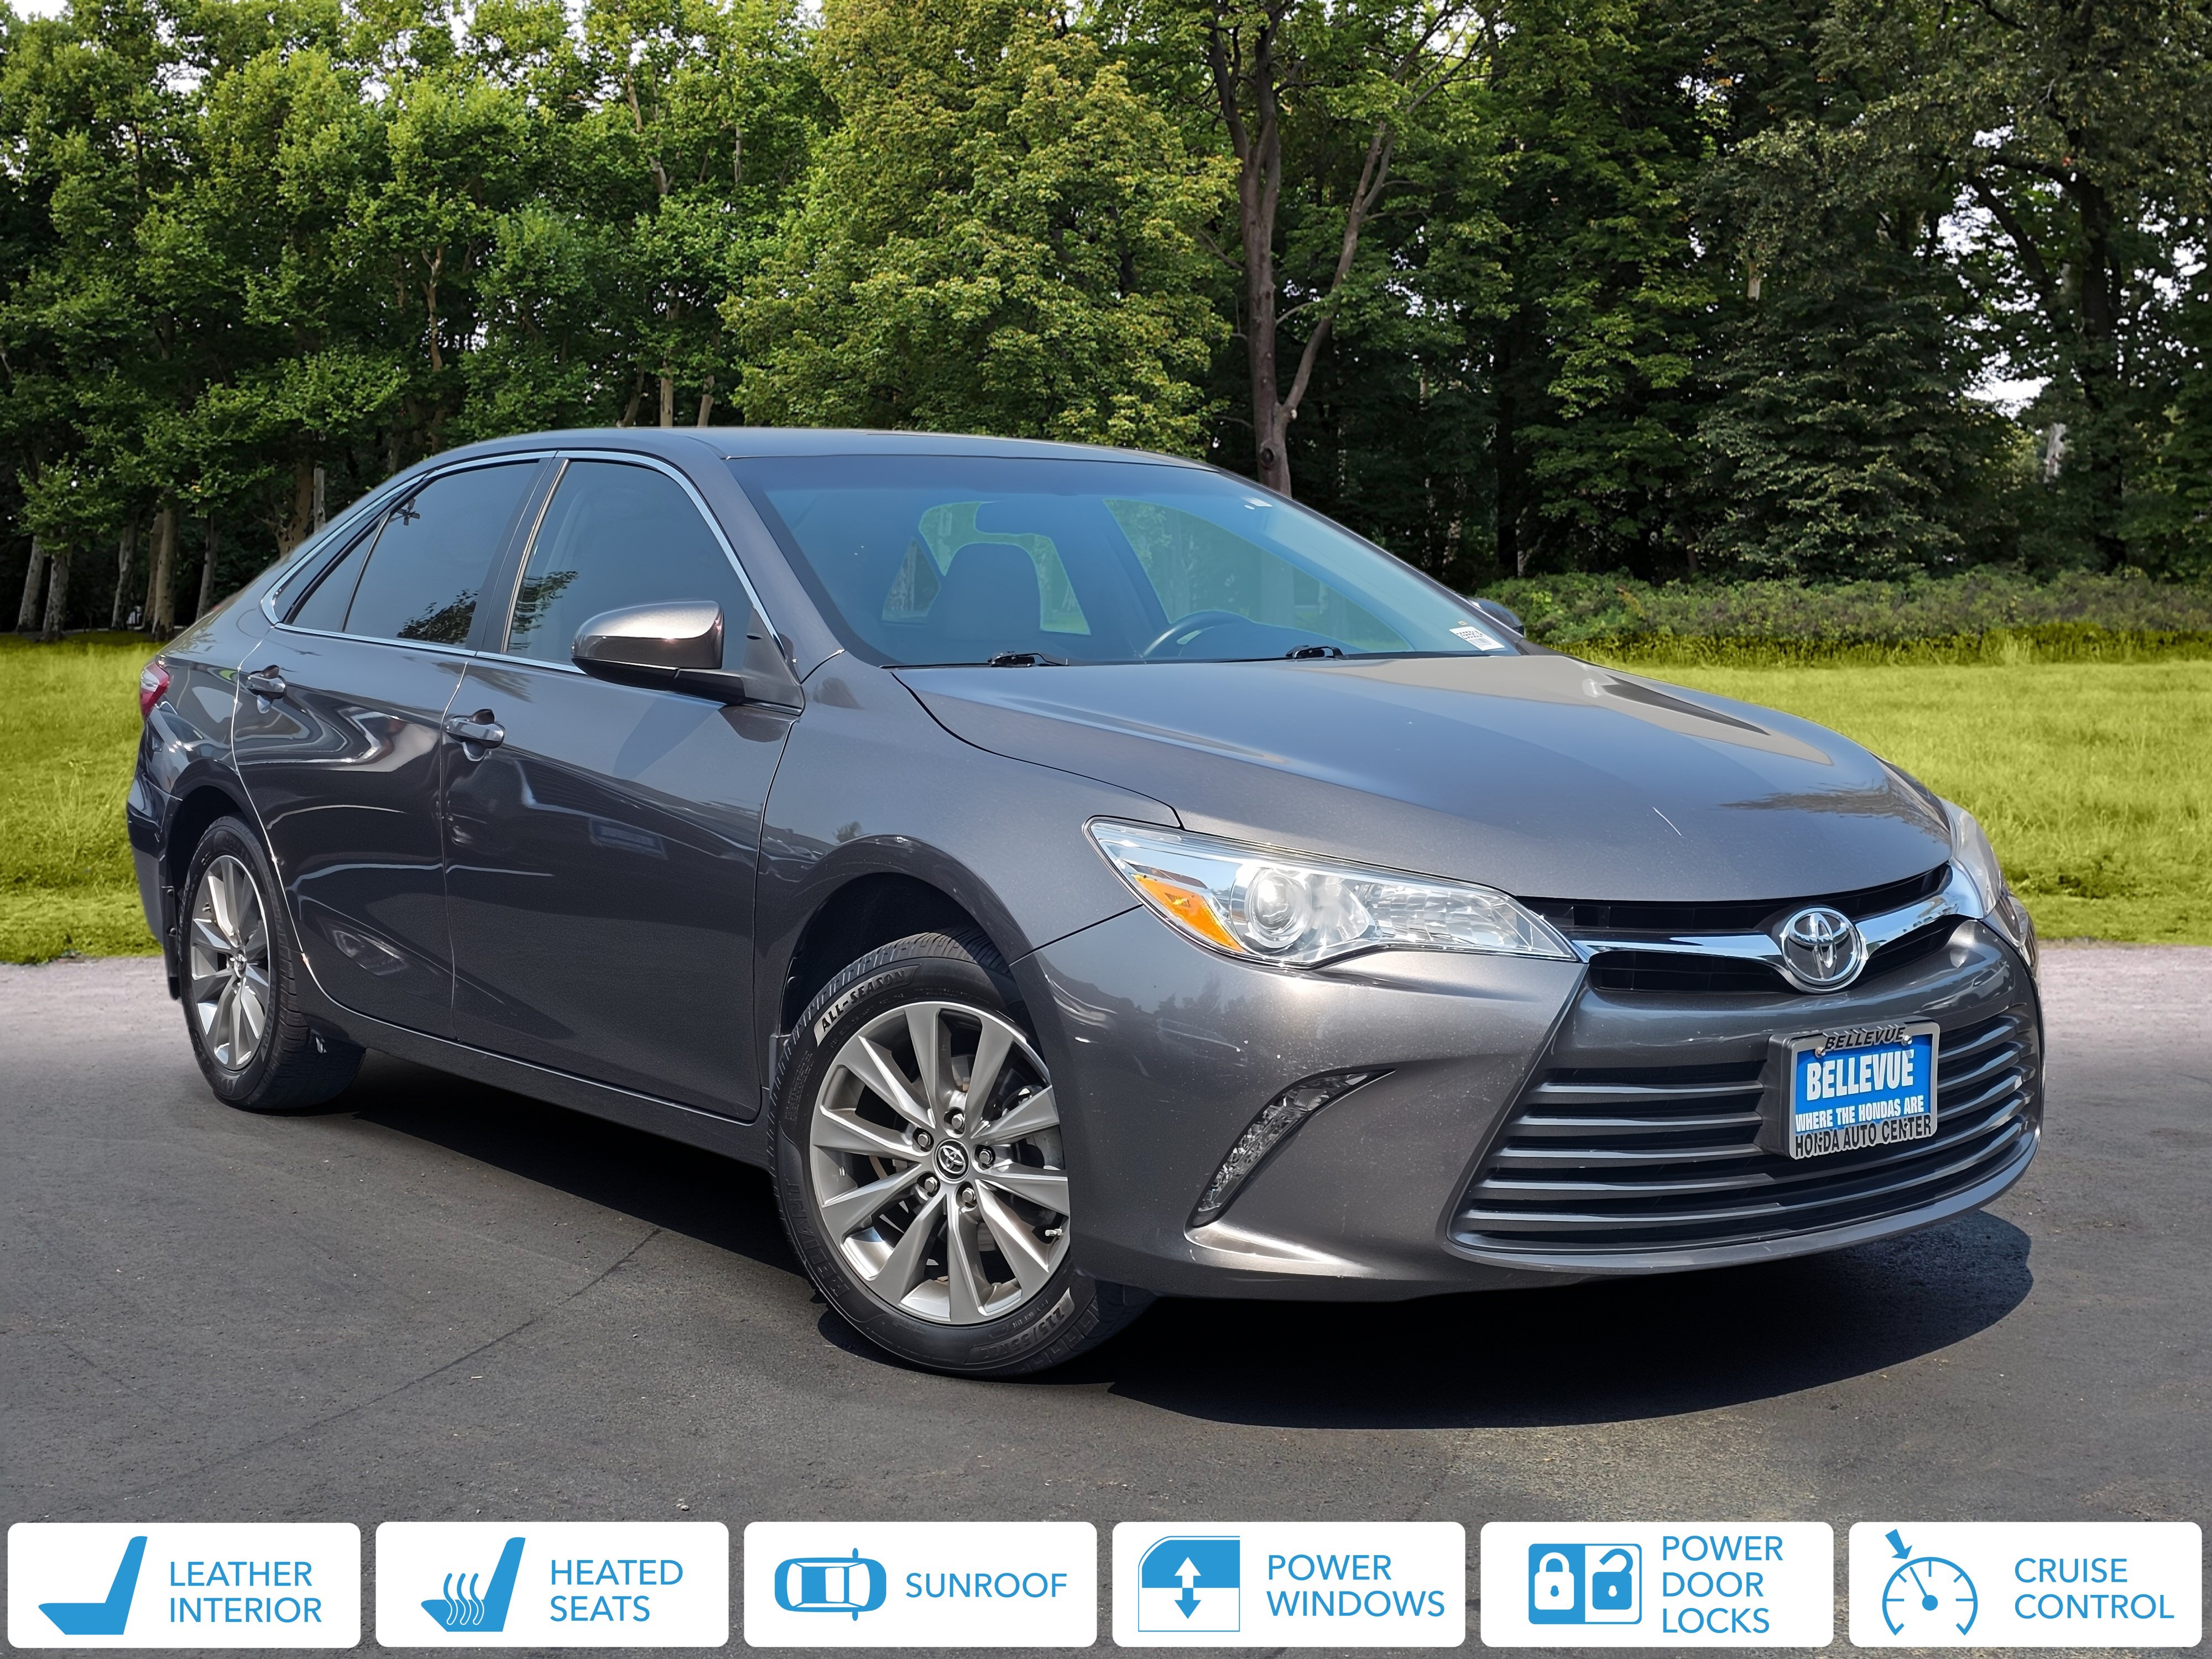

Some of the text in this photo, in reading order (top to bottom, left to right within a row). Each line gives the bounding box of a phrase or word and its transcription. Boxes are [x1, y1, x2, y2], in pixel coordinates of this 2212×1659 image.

[821, 970, 905, 1032] ALL-SEASON
[1825, 1026, 1906, 1050] BELLEVUE
[1806, 1048, 1914, 1101] BELLEVUE
[1795, 1095, 1924, 1132] WHERE THE HONDAS ARE
[1795, 1115, 1932, 1157] HONDA AUTO CENTER
